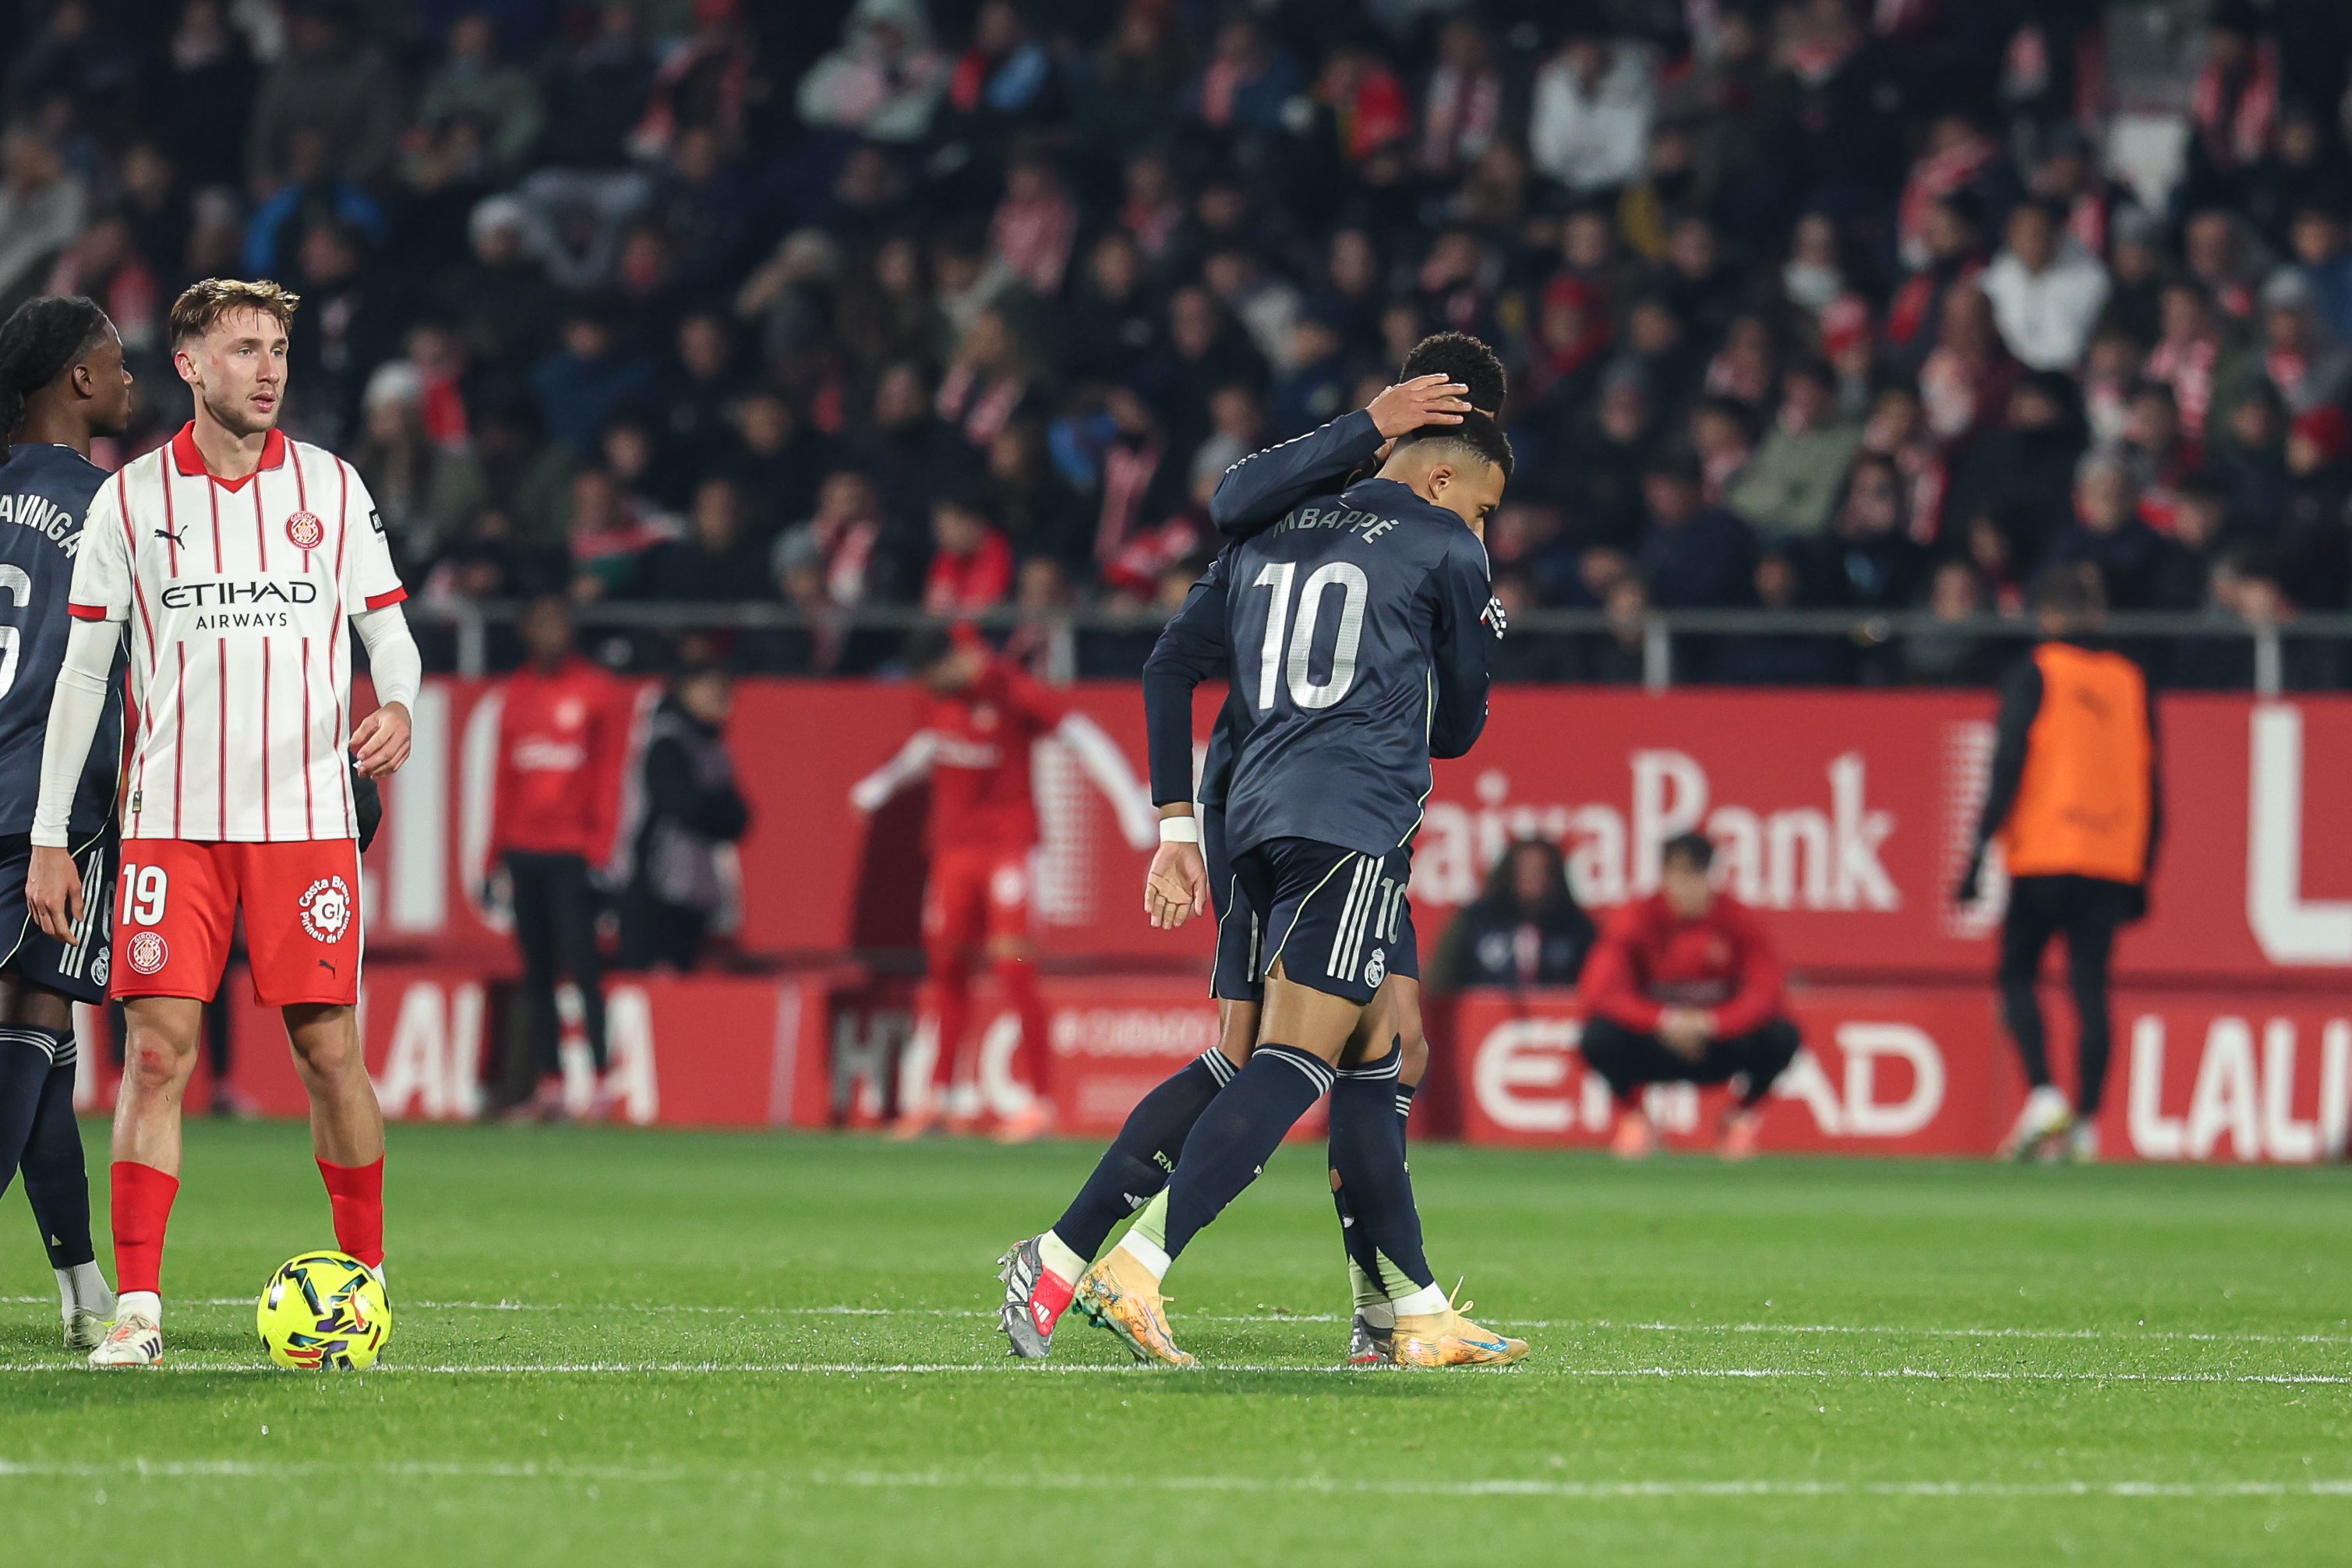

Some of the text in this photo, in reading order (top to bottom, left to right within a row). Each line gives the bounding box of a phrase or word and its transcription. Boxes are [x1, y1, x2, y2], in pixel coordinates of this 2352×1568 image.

[1273, 508, 1400, 544] MBAPPÉ
[161, 581, 316, 609] ETIHAD
[196, 613, 288, 630] AIRWAYS
[1252, 561, 1368, 710] 10
[122, 863, 168, 926] 19
[298, 879, 330, 907] Costa
[322, 902, 341, 920] G!
[1372, 878, 1407, 945] 10
[134, 934, 161, 945] GIRONA
[299, 911, 325, 942] Pirineu
